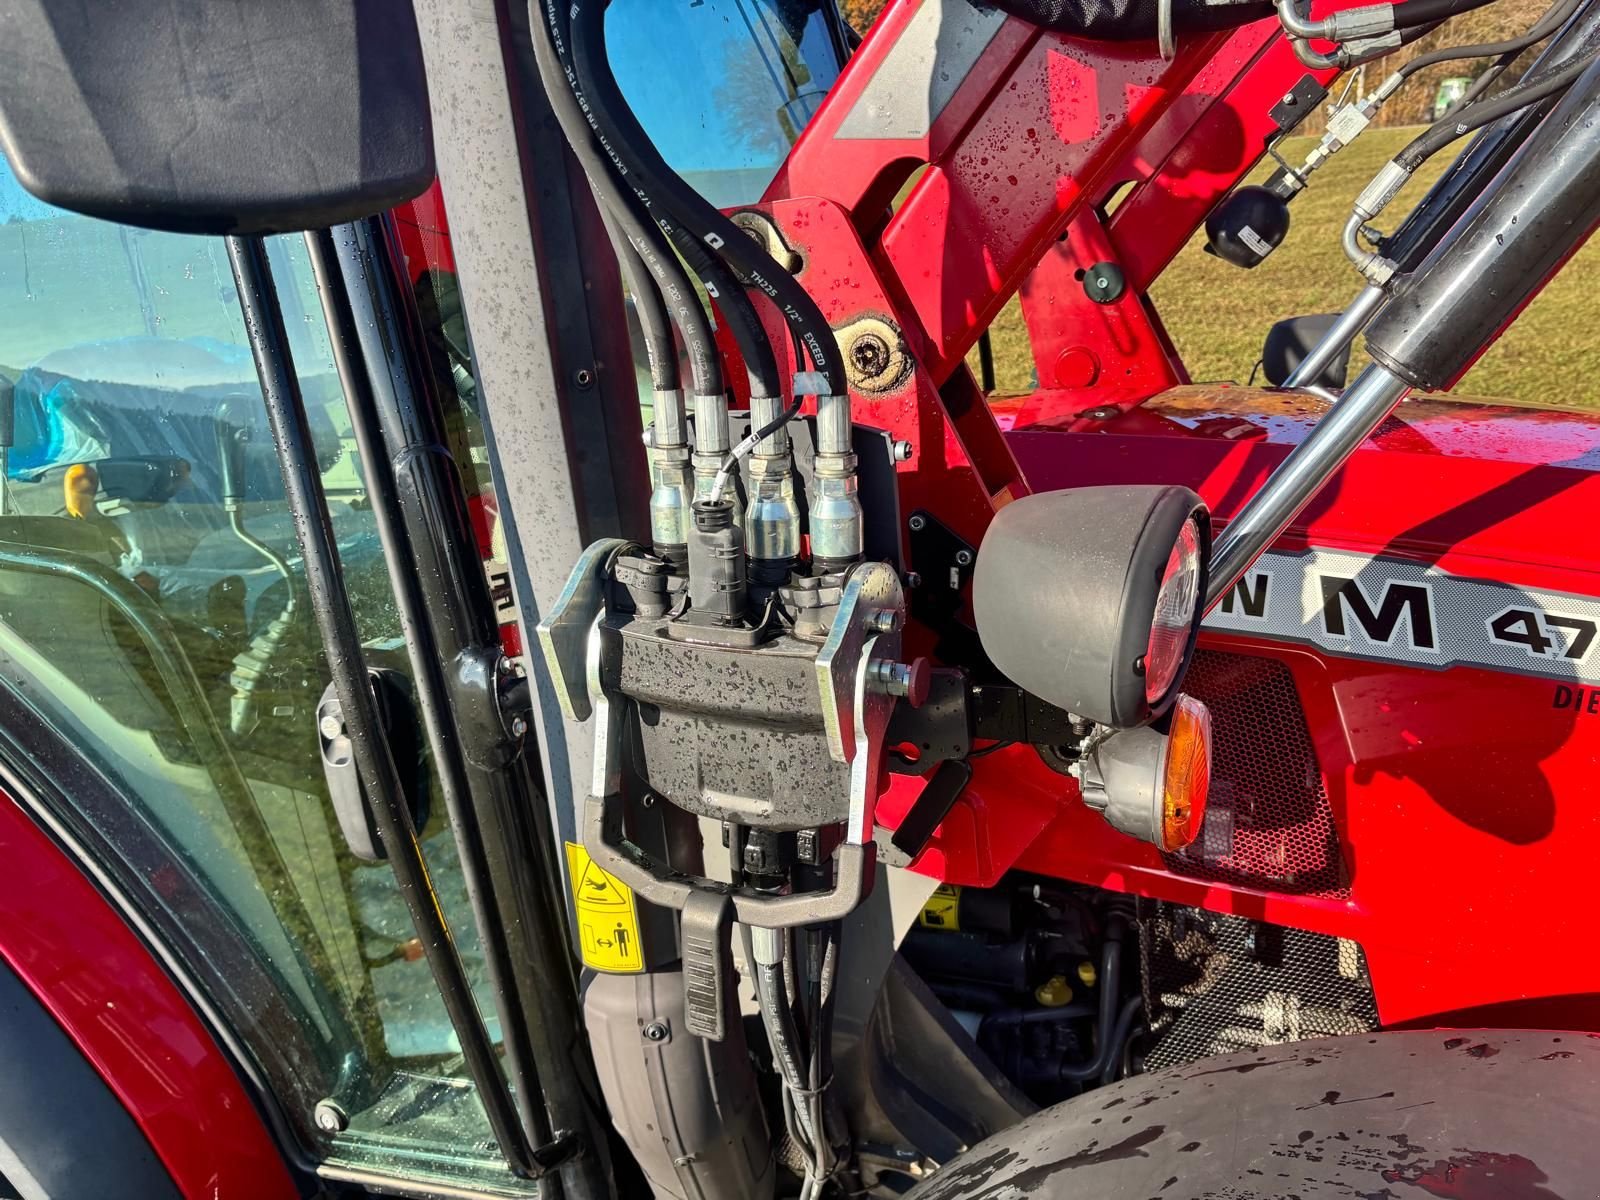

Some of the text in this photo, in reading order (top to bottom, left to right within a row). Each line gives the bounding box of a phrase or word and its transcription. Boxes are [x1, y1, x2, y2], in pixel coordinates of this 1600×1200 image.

[751, 270, 779, 297] TH225
[784, 304, 803, 323] 1/2"
[804, 331, 826, 367] EXCEED
[1320, 575, 1435, 649] M
[1491, 609, 1598, 660] 47
